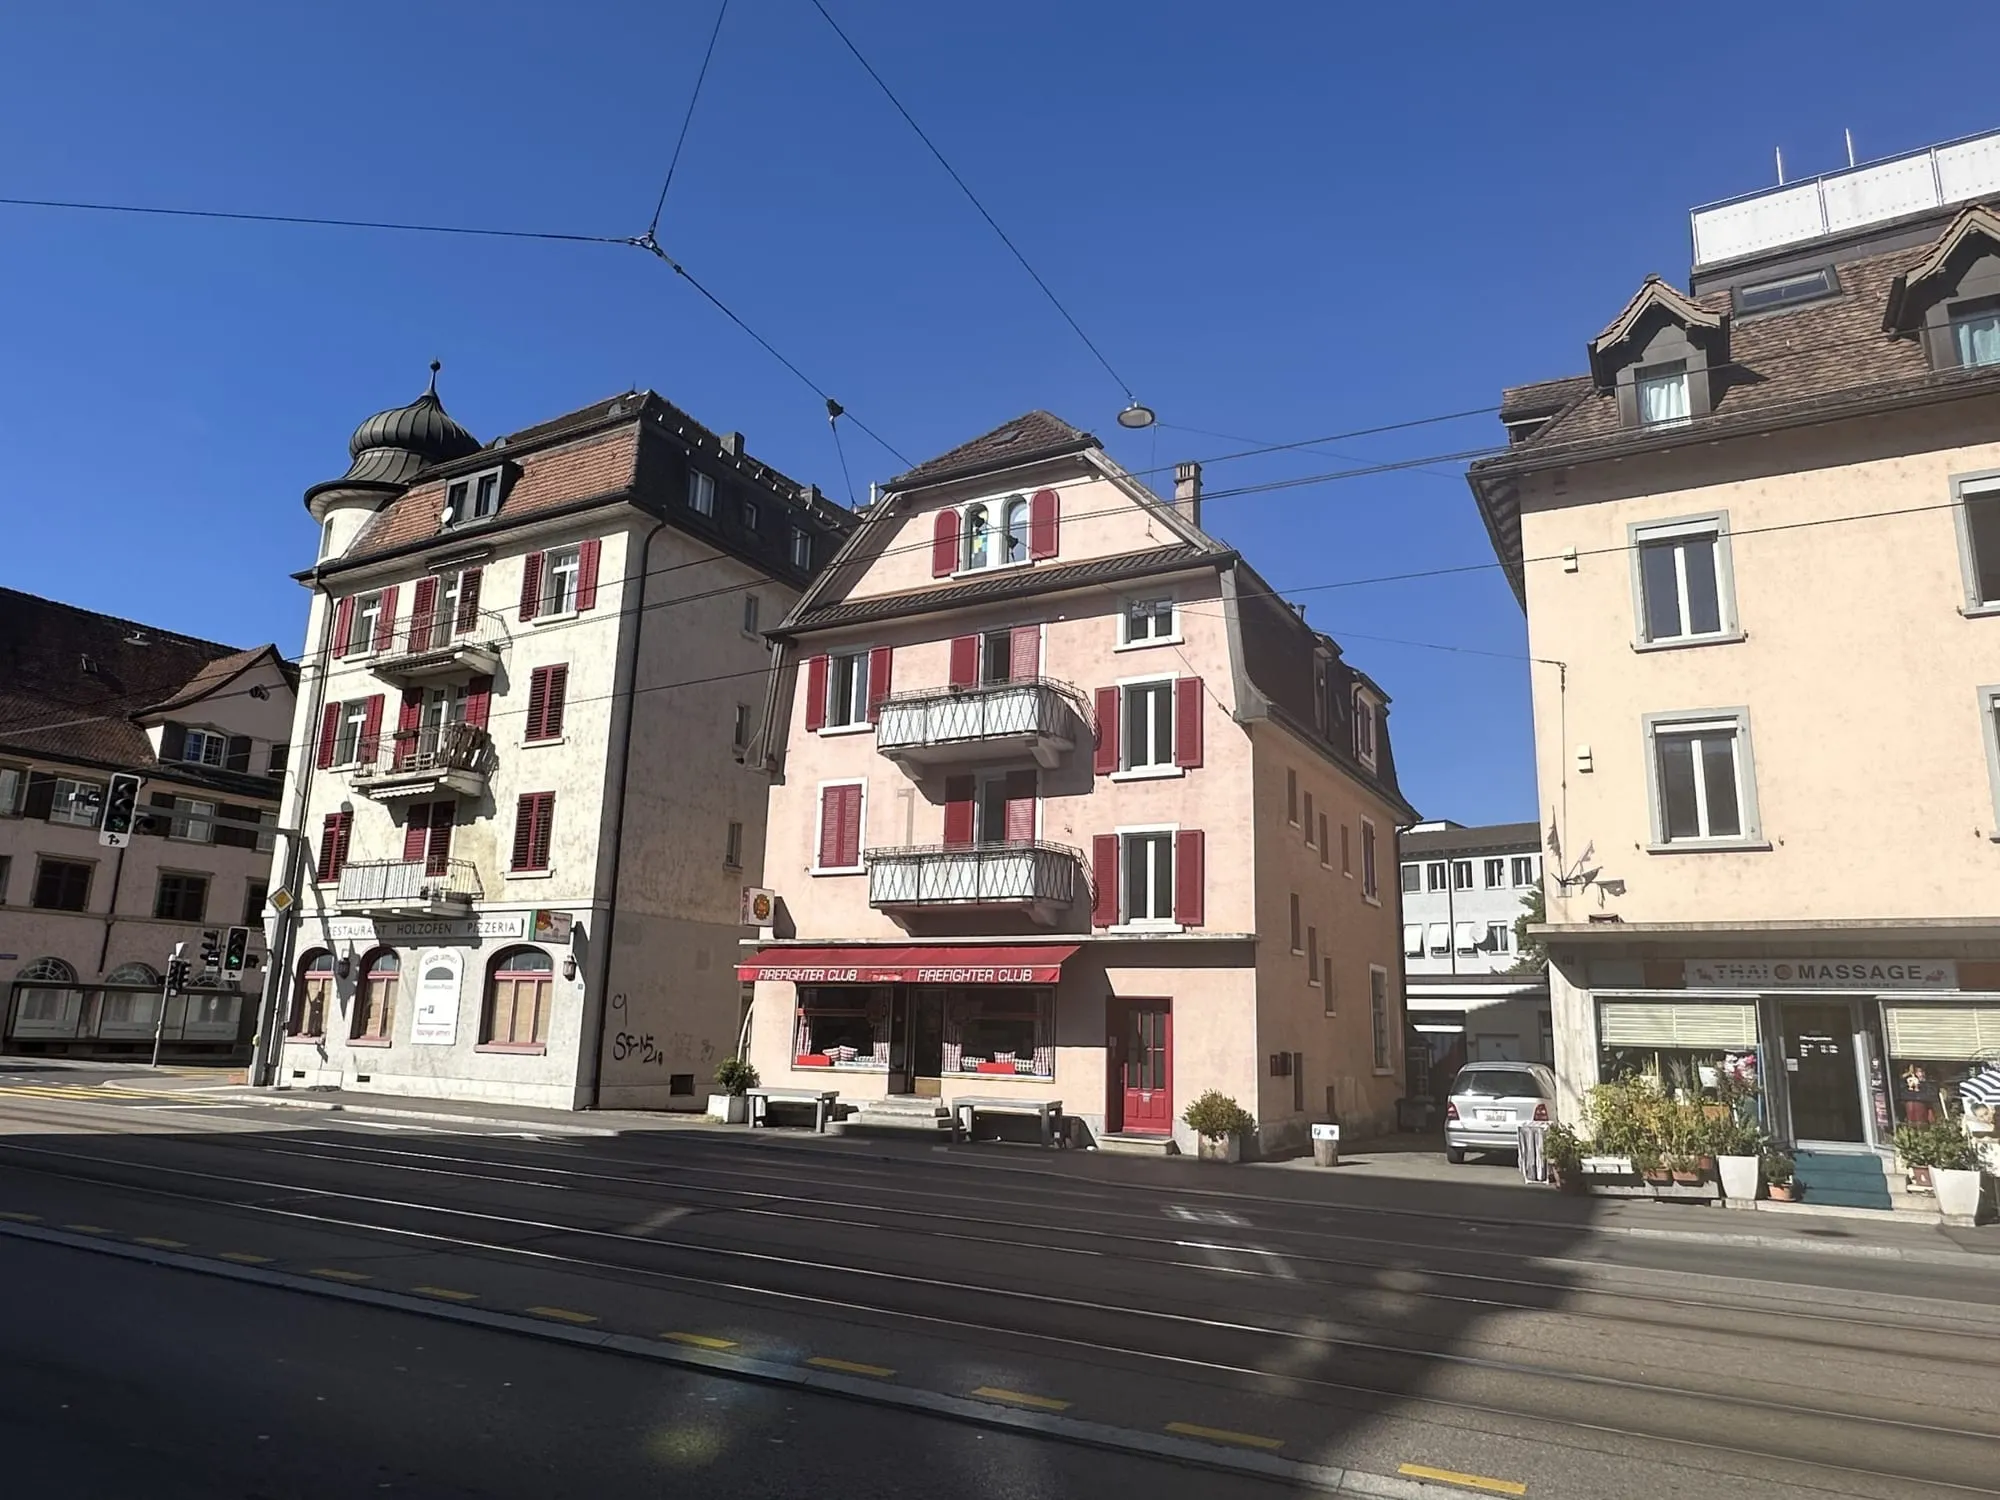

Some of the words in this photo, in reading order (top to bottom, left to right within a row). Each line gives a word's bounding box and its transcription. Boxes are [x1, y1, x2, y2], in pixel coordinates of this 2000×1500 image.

[396, 922, 453, 935] HOLZOFEN
[467, 921, 516, 934] PIZZERIA
[758, 968, 825, 981] FIREFIGHTER
[827, 969, 857, 981] CLUB
[917, 968, 994, 982] FIREFIGHTER
[998, 968, 1033, 982] CLUB
[1713, 964, 1768, 979] THAI
[1798, 964, 1922, 980] MASSAGE
